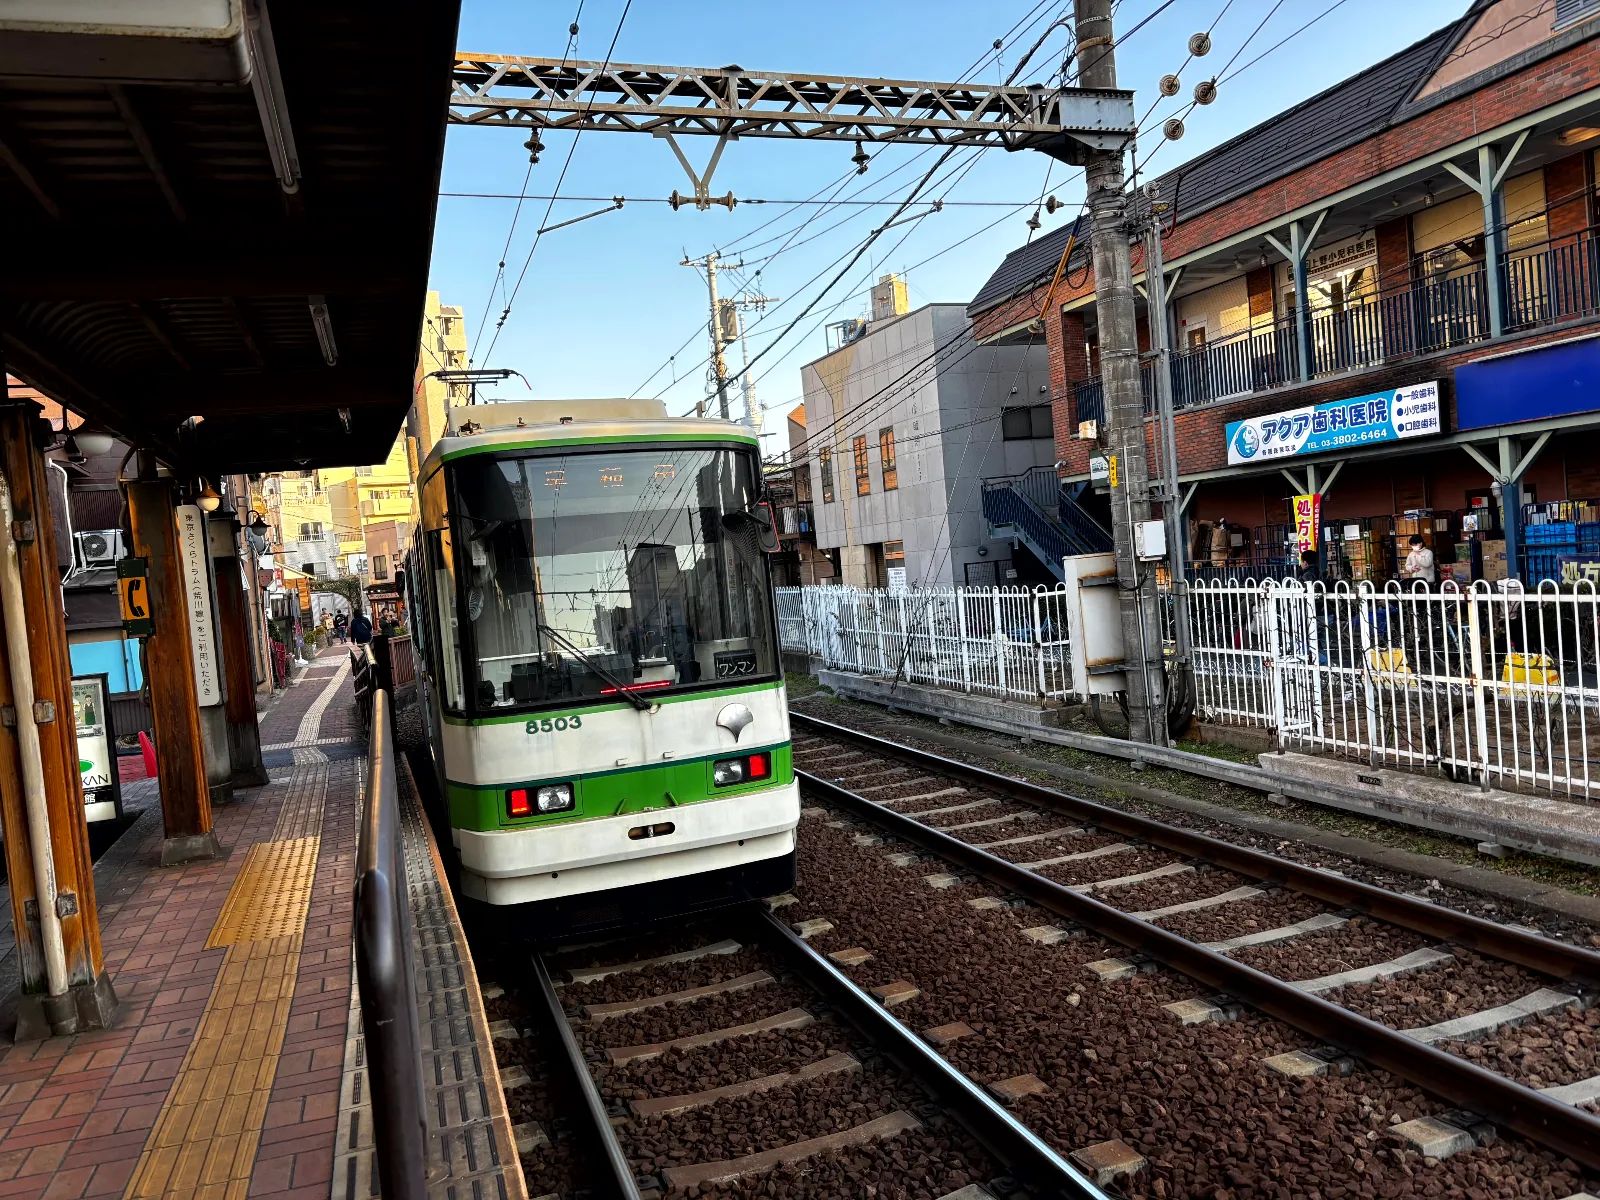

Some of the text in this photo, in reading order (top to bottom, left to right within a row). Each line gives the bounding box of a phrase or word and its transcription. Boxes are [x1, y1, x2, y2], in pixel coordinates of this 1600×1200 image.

[1403, 386, 1436, 400] 一般歯科
[1404, 401, 1436, 416] 小児歯科
[1261, 399, 1388, 444] アクア歯科医院
[1405, 417, 1437, 431] 口腔歯科
[1321, 429, 1388, 447] 03-3802-6464
[719, 660, 756, 676] ワンマン
[526, 715, 582, 735] 8503
